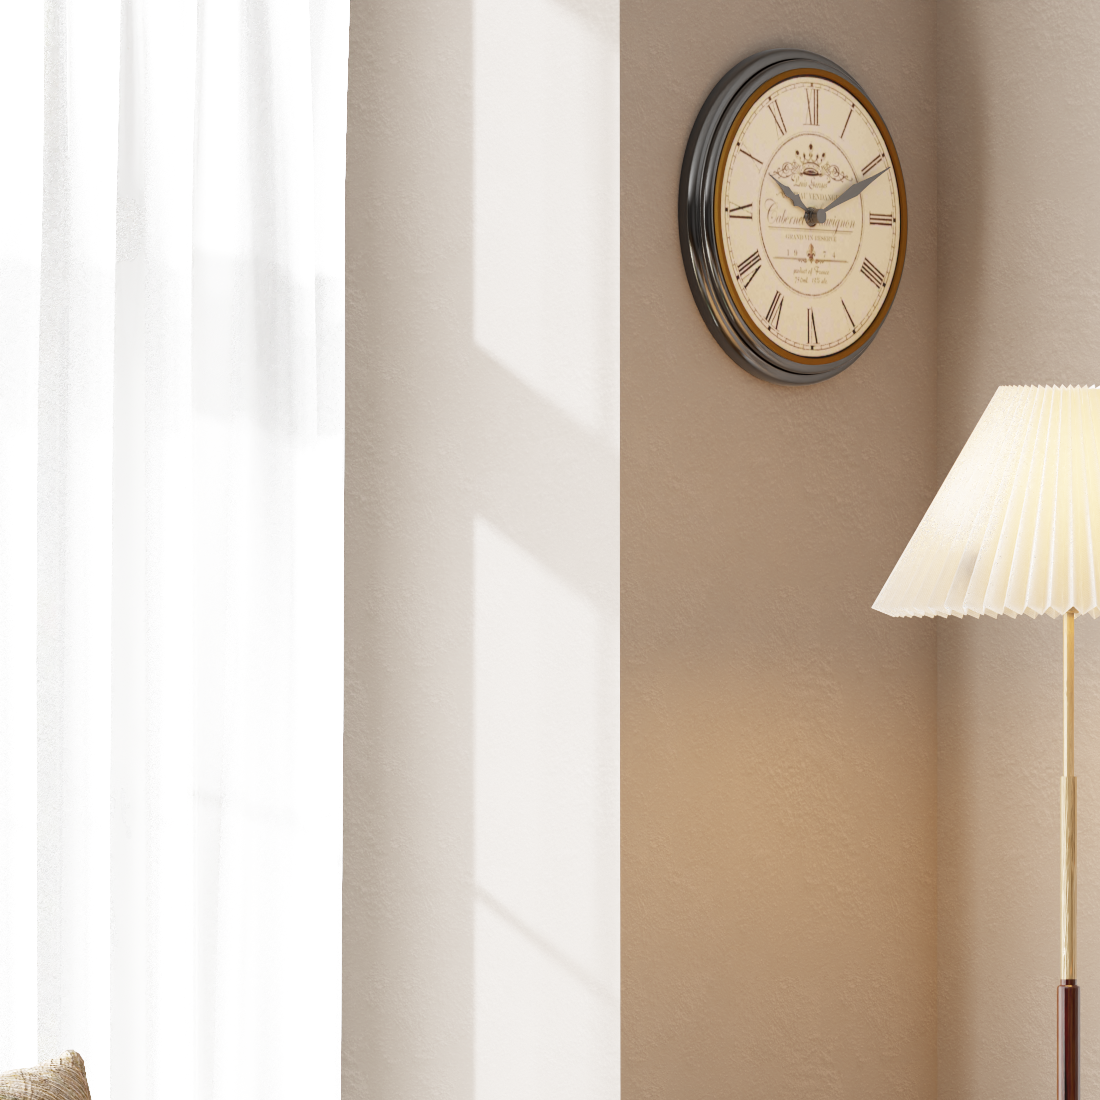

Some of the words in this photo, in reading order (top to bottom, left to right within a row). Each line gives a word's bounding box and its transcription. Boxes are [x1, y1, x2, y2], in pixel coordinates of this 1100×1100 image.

[803, 88, 820, 127] XII
[764, 197, 808, 226] Caberne
[869, 213, 893, 227] III
